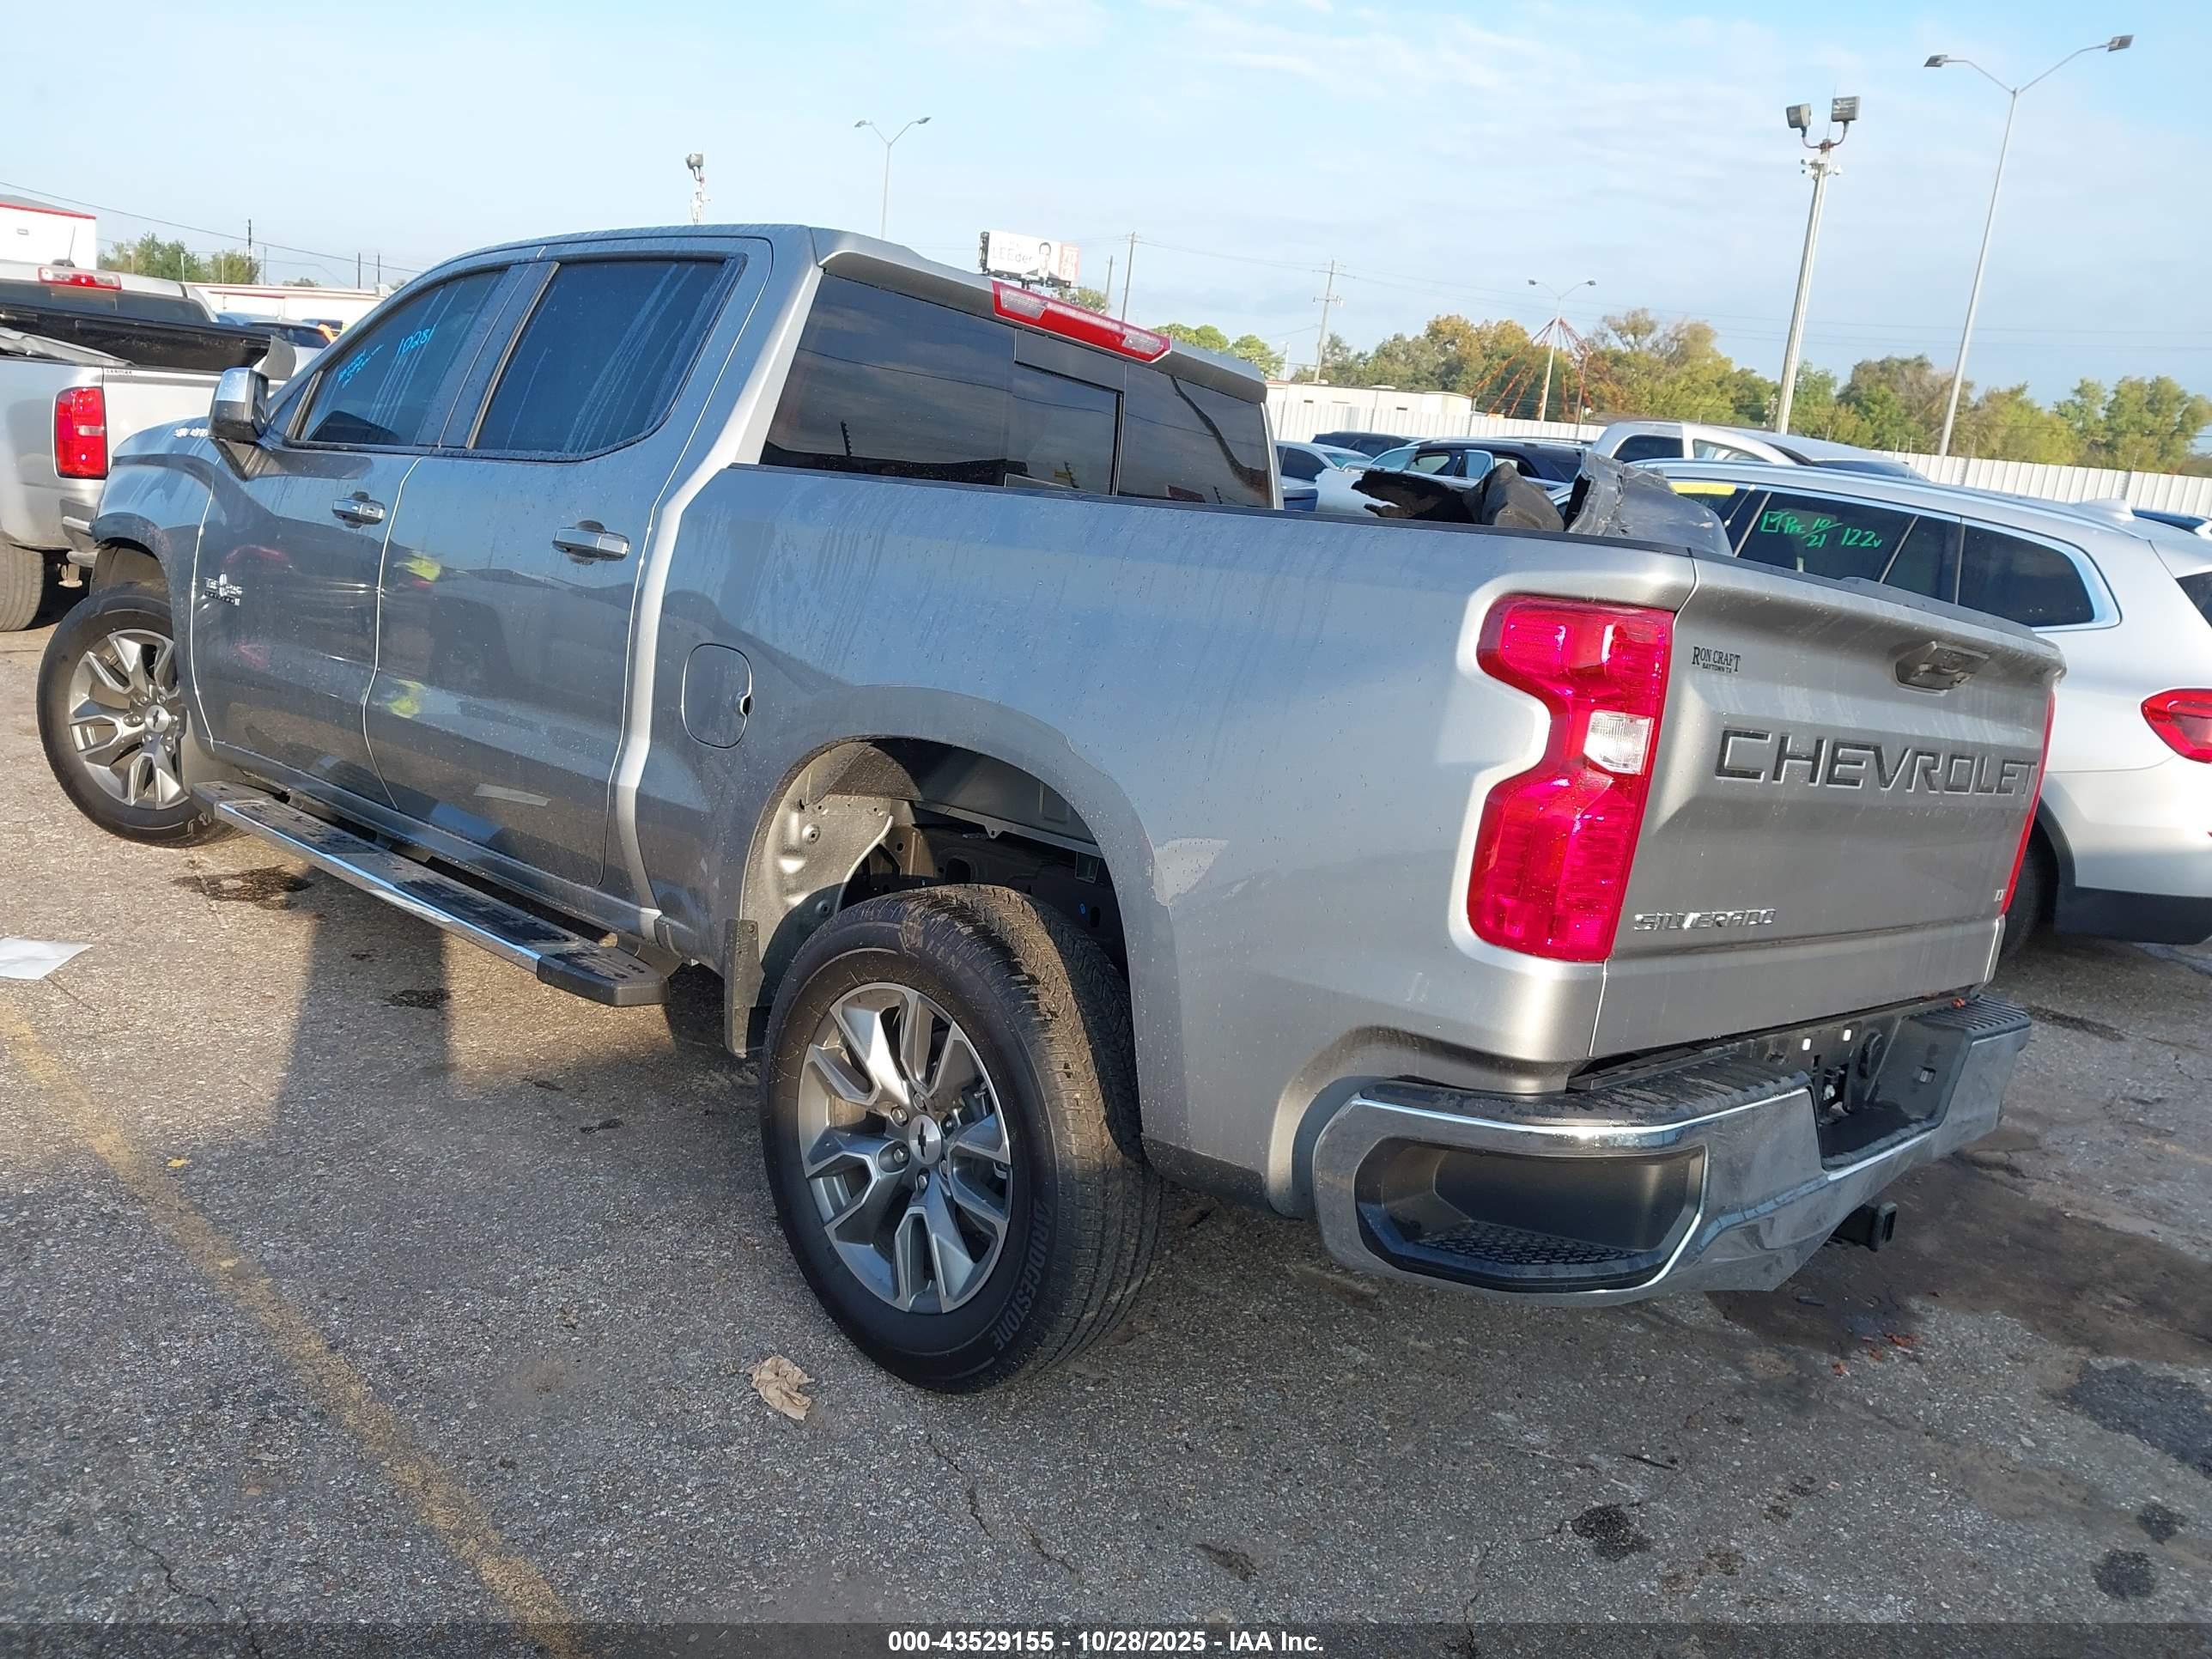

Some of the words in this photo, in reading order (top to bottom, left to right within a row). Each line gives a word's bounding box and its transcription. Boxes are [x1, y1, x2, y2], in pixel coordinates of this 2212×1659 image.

[1712, 650, 1741, 672] CRAFT
[1715, 728, 2039, 796] CHEVROLET
[1633, 908, 1776, 932] SILVERADO
[989, 1197, 1053, 1352] BRIDGESTONE
